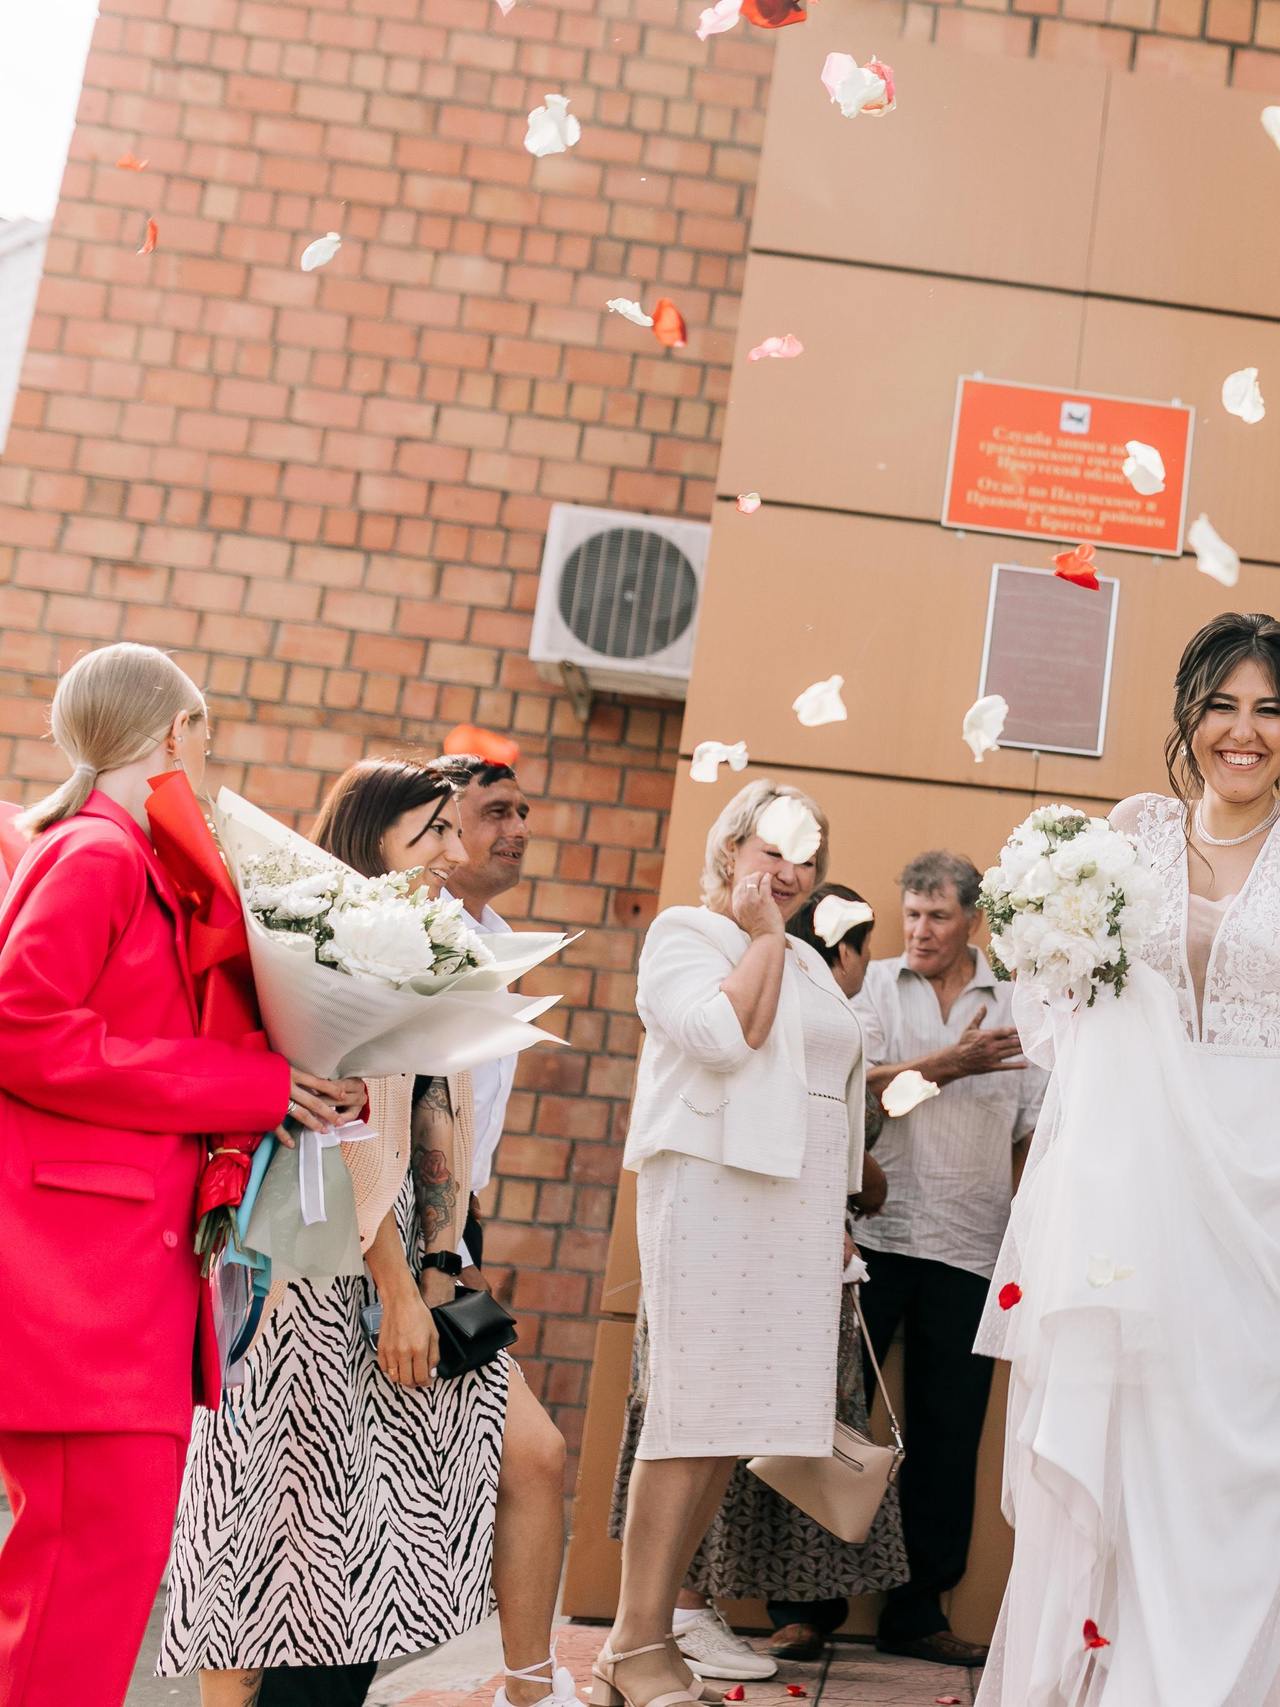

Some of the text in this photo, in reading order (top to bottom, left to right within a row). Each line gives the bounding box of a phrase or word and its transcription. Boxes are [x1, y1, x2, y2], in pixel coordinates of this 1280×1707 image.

[993, 426, 1052, 445] Служба
[997, 454, 1081, 477] Иркутской
[1028, 486, 1048, 498] по
